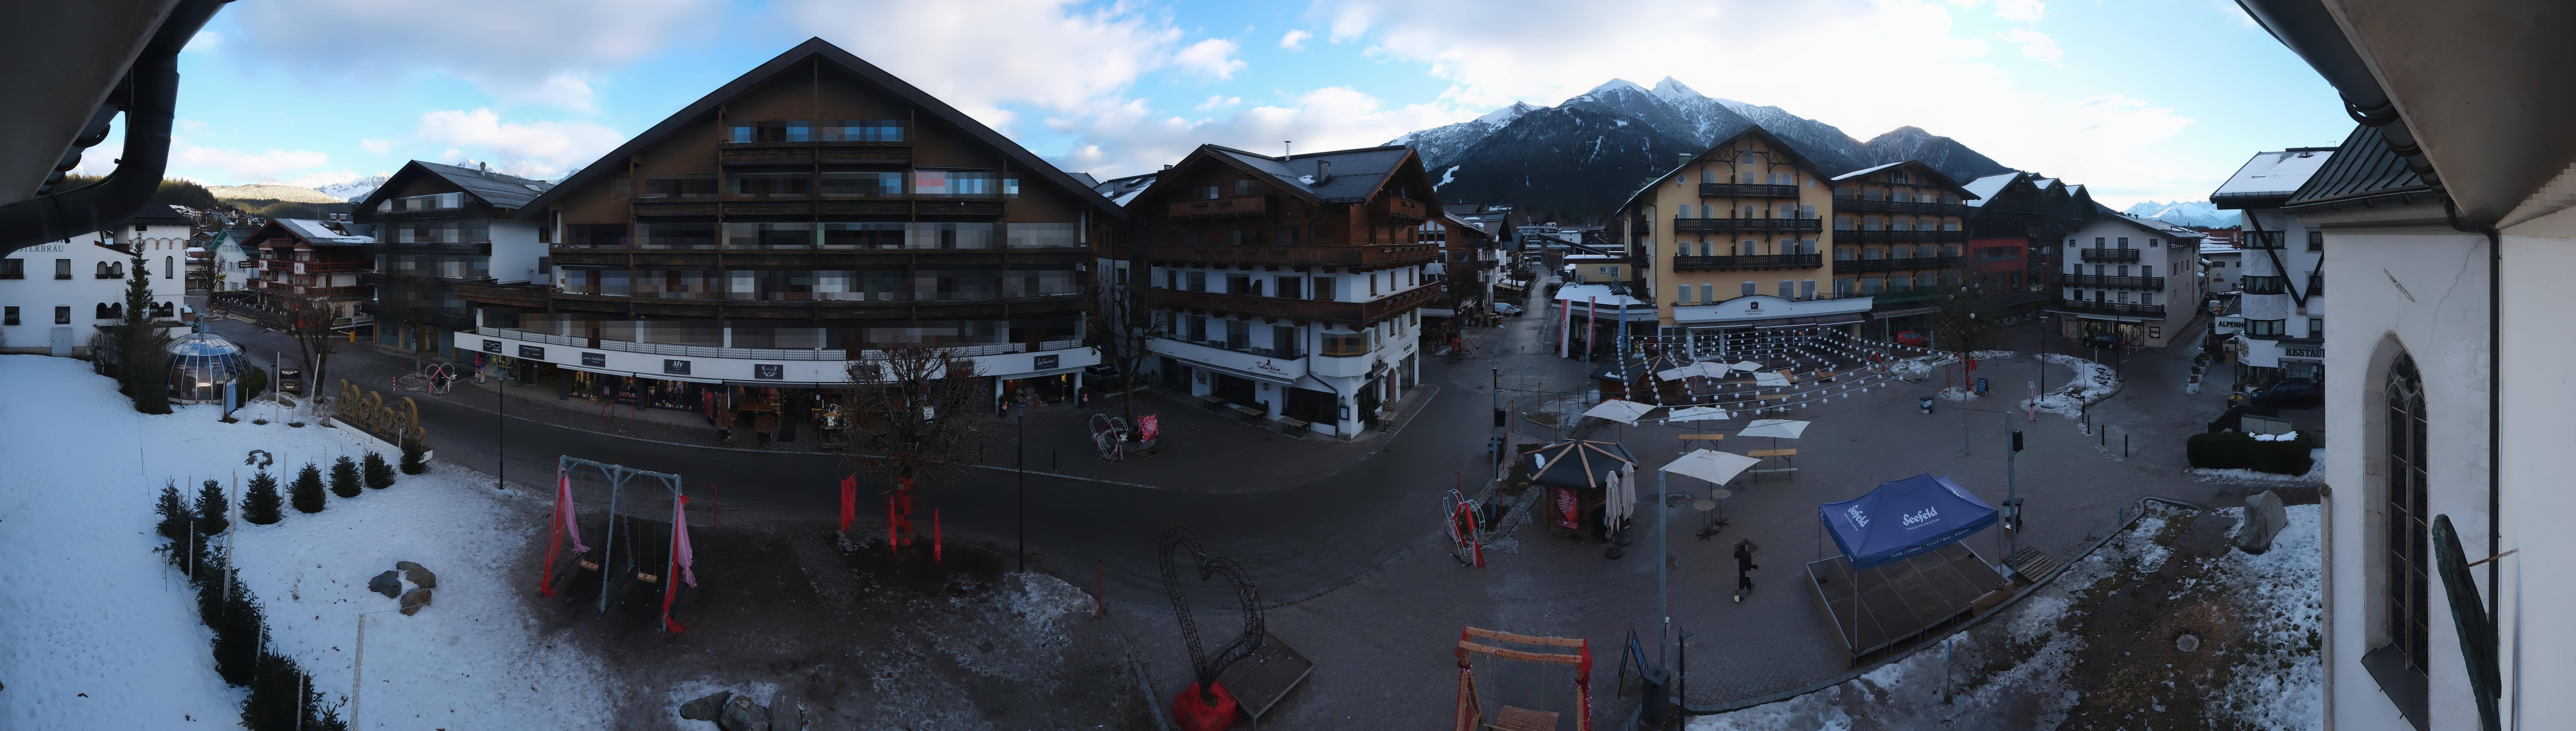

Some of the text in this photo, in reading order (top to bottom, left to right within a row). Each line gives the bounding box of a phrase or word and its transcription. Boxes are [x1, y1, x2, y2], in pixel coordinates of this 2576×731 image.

[1403, 343, 1412, 352] SAILER
[1373, 364, 1387, 377] RESTAURANT
[1848, 505, 1869, 528] Seefeld
[1903, 506, 1938, 526] Seefeld
[1918, 518, 1940, 528] HOCHPLATEAU
[1955, 528, 1970, 536] Scharnitz
